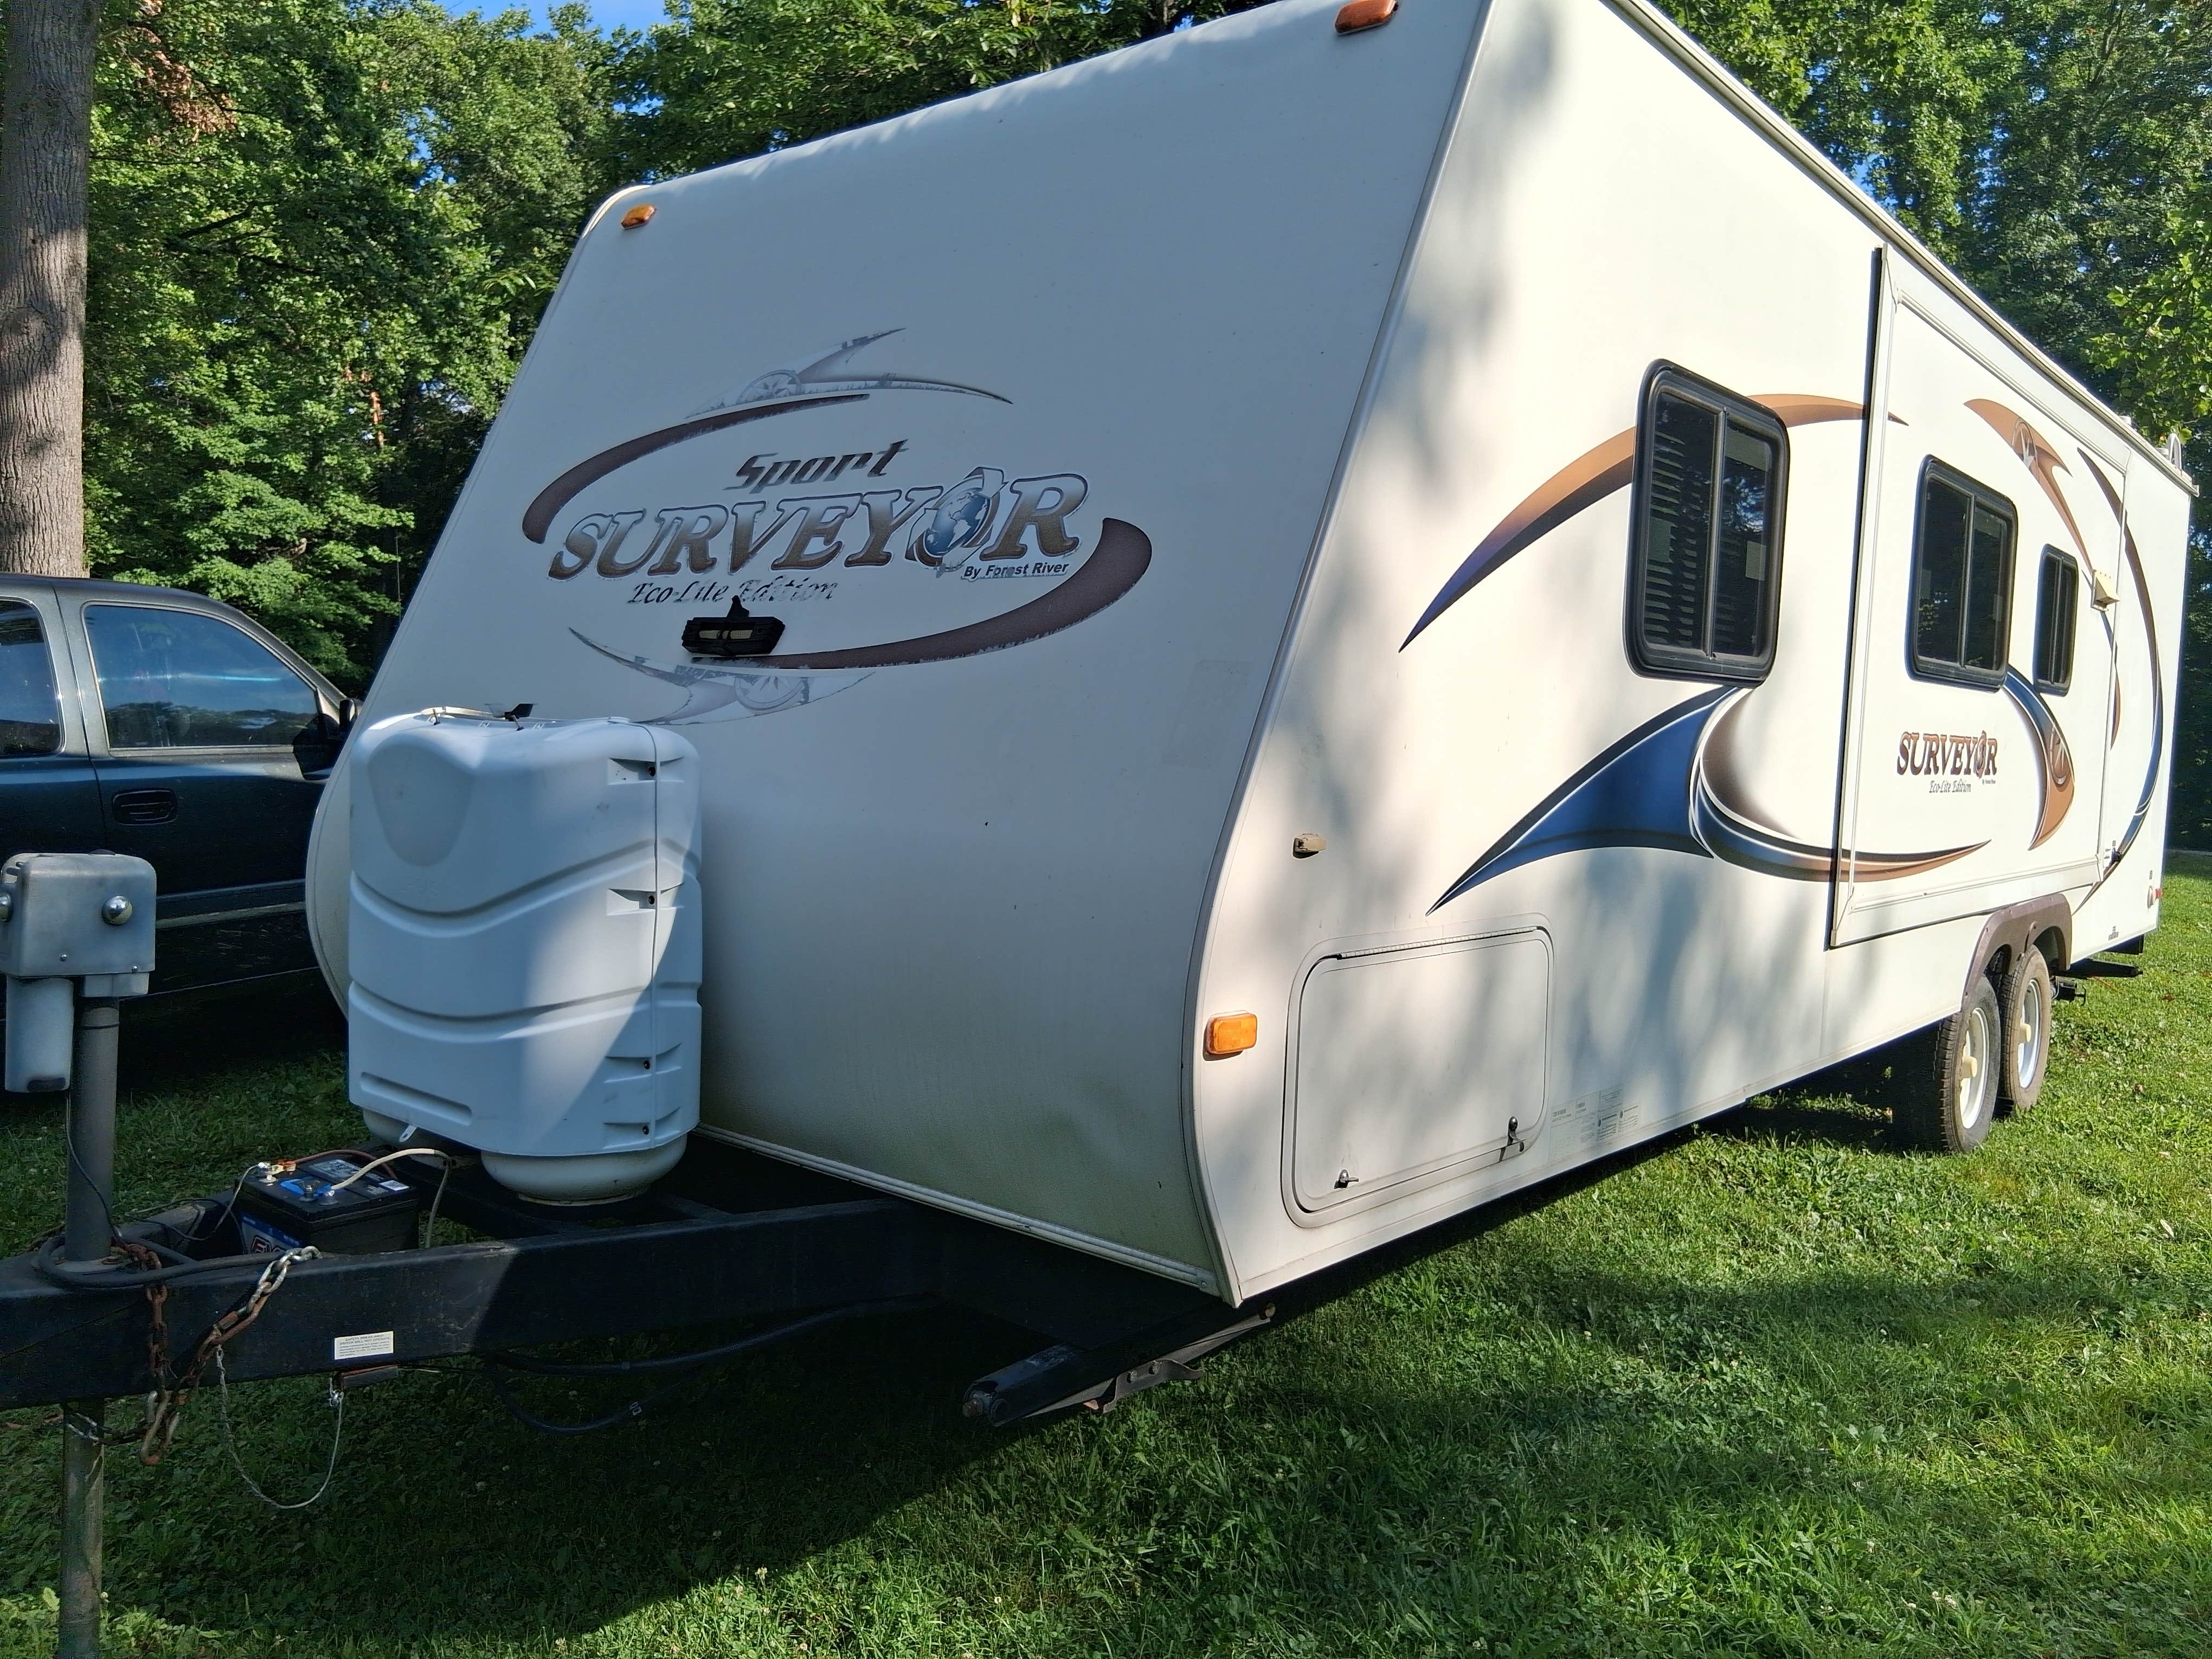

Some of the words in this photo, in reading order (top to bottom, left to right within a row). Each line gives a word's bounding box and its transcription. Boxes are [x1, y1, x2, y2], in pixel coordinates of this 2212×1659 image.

[723, 439, 909, 494] Sport
[548, 467, 1088, 580] SURVEYOR
[963, 565, 981, 580] By
[985, 563, 1030, 576] Forst
[1032, 562, 1070, 574] River
[1896, 730, 1998, 779] SURVEYOR
